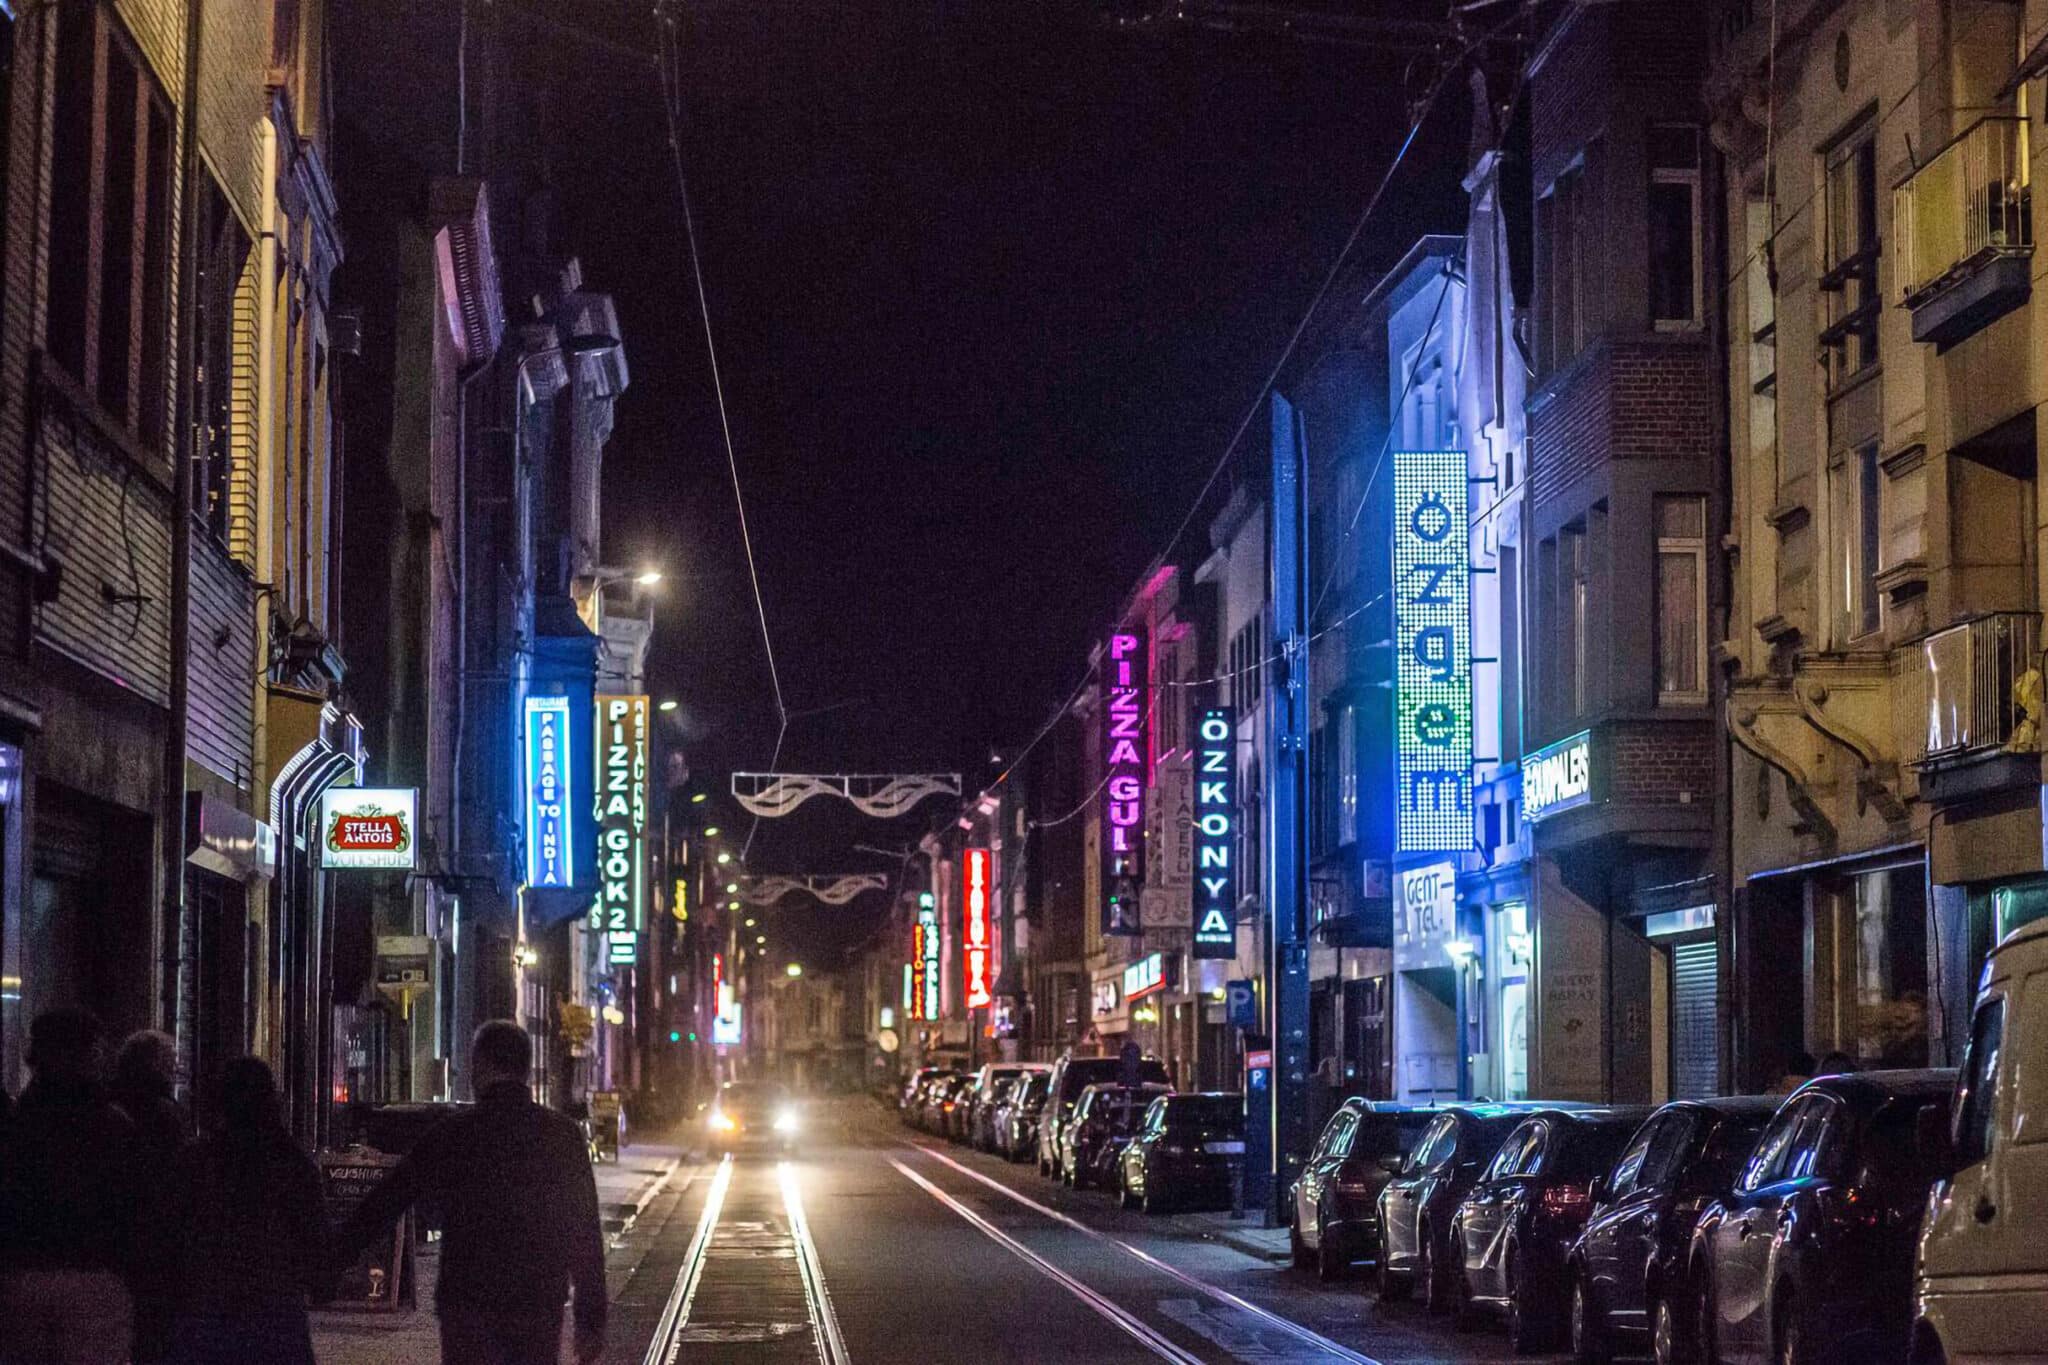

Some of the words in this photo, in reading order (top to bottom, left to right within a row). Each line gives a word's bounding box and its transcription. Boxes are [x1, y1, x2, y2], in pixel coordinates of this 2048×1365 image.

[1109, 635, 1140, 764] PIZZA
[541, 712, 556, 801] PASSAGE
[606, 700, 629, 816] PIZZA
[344, 822, 392, 833] STELLA
[344, 833, 394, 844] ARTOIS
[537, 804, 561, 818] TO
[1201, 710, 1229, 931] ÖZKONYA
[543, 820, 557, 885] INDIA
[605, 829, 630, 902] GÖK
[1229, 987, 1251, 1020] P
[1252, 1069, 1264, 1085] P
